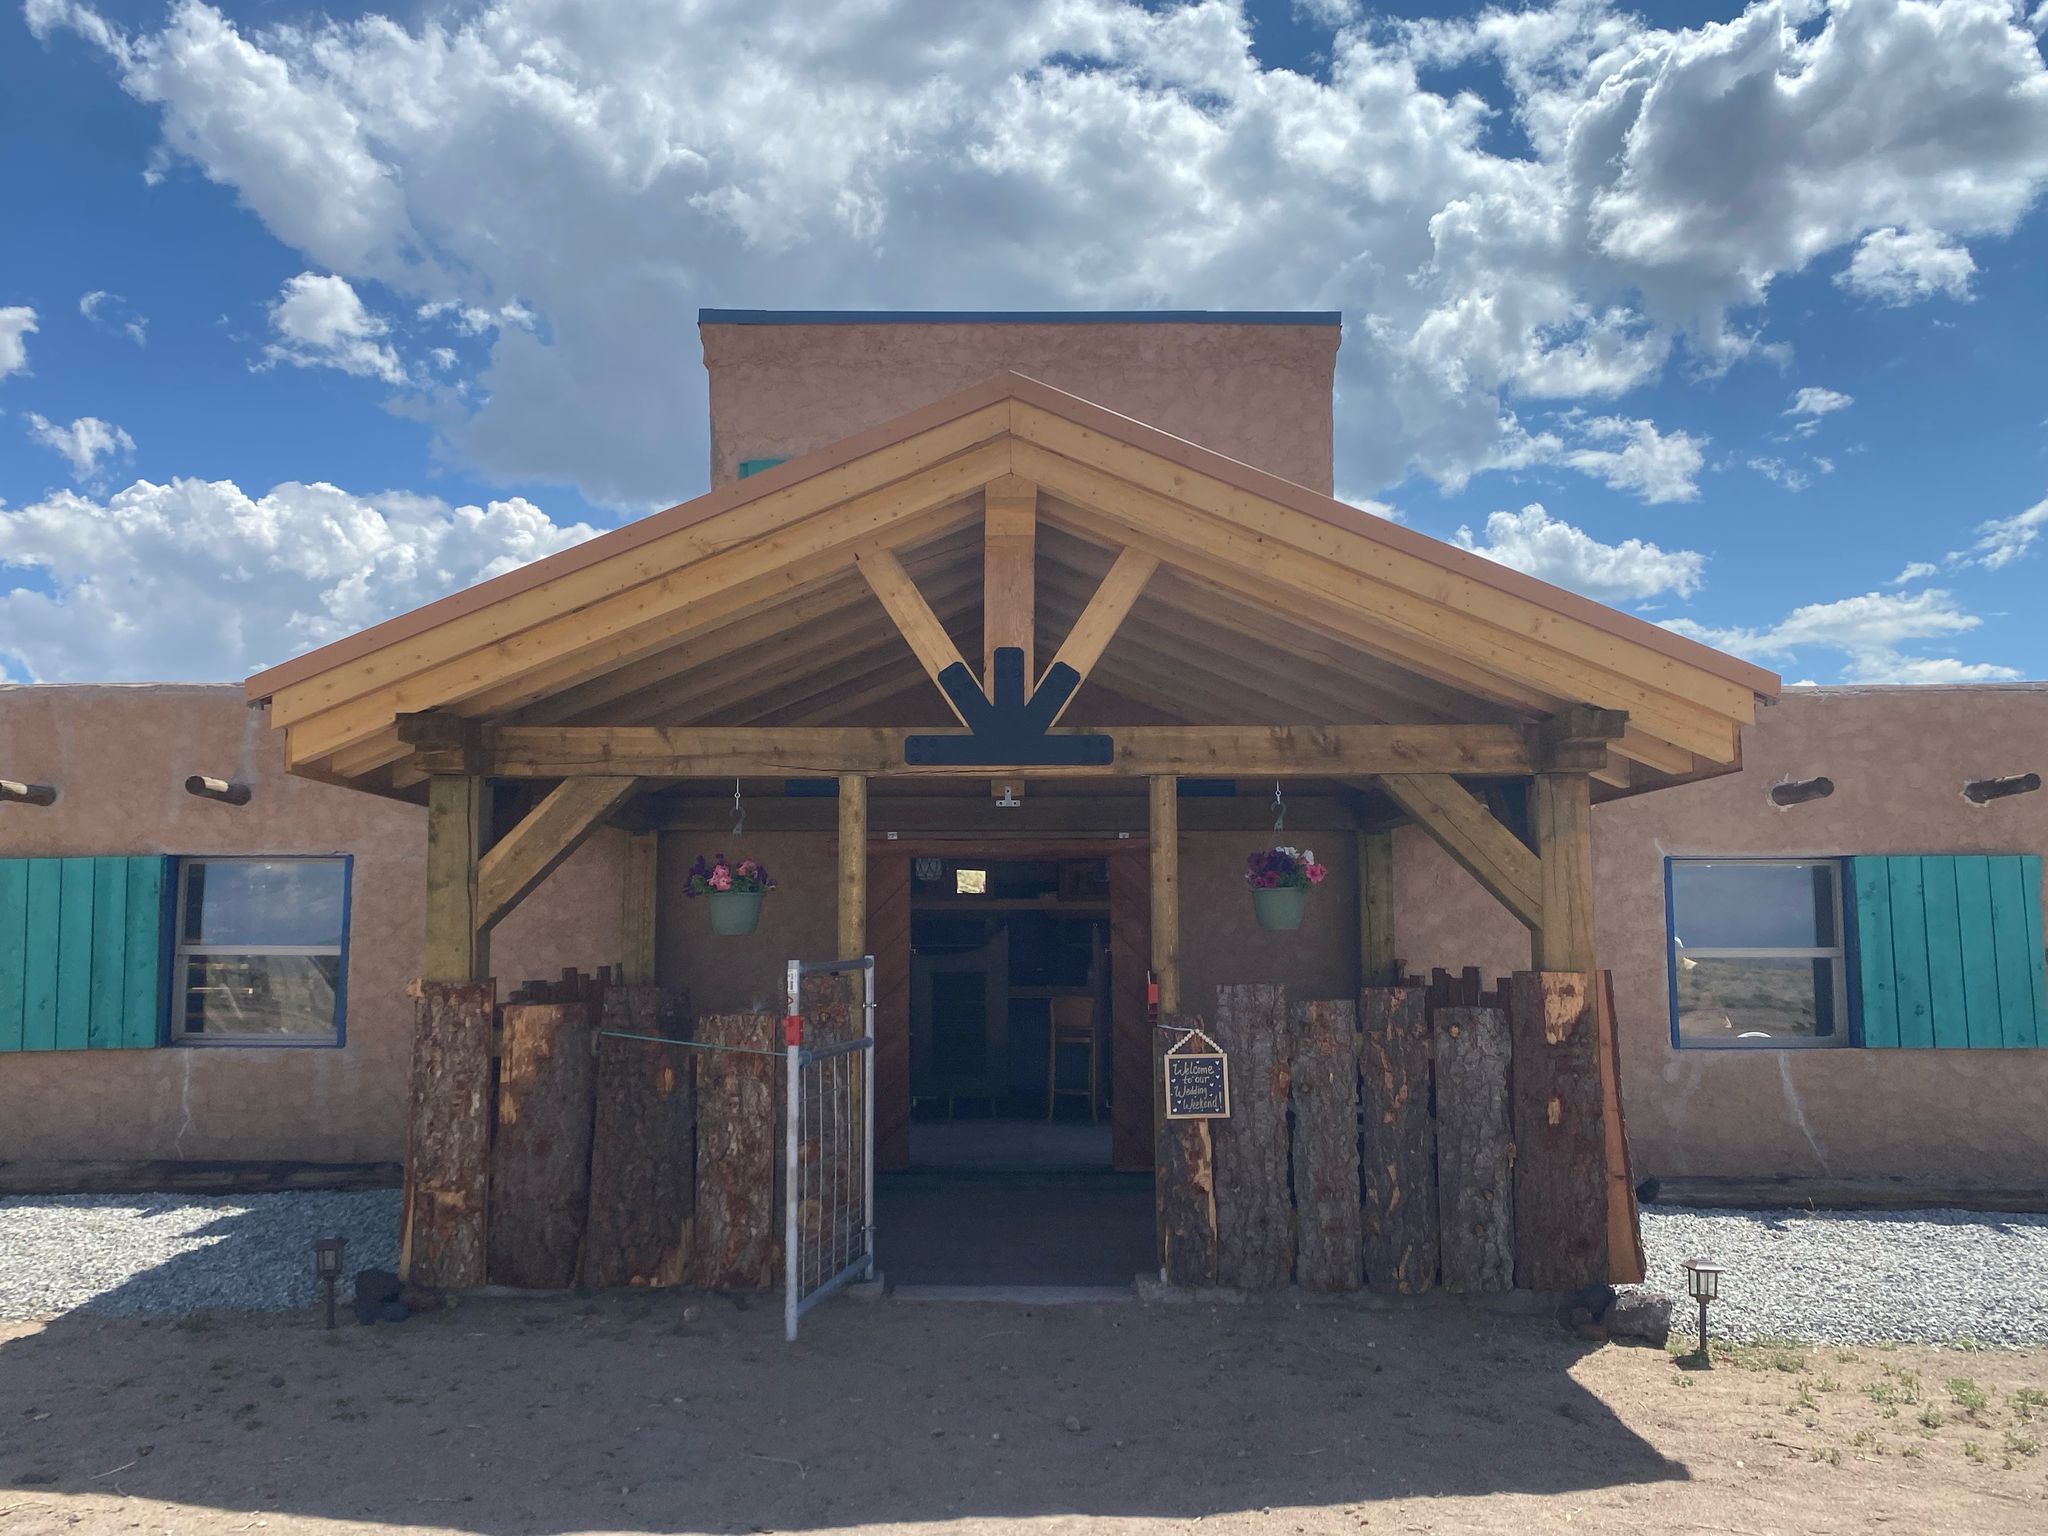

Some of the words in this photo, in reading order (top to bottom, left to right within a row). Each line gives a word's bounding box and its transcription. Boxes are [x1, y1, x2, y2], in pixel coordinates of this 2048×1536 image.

[1172, 1062, 1215, 1076] Welcome
[1183, 1076, 1193, 1084] to
[1173, 1085, 1208, 1099] Wedding
[1183, 1092, 1222, 1109] Weekend!
